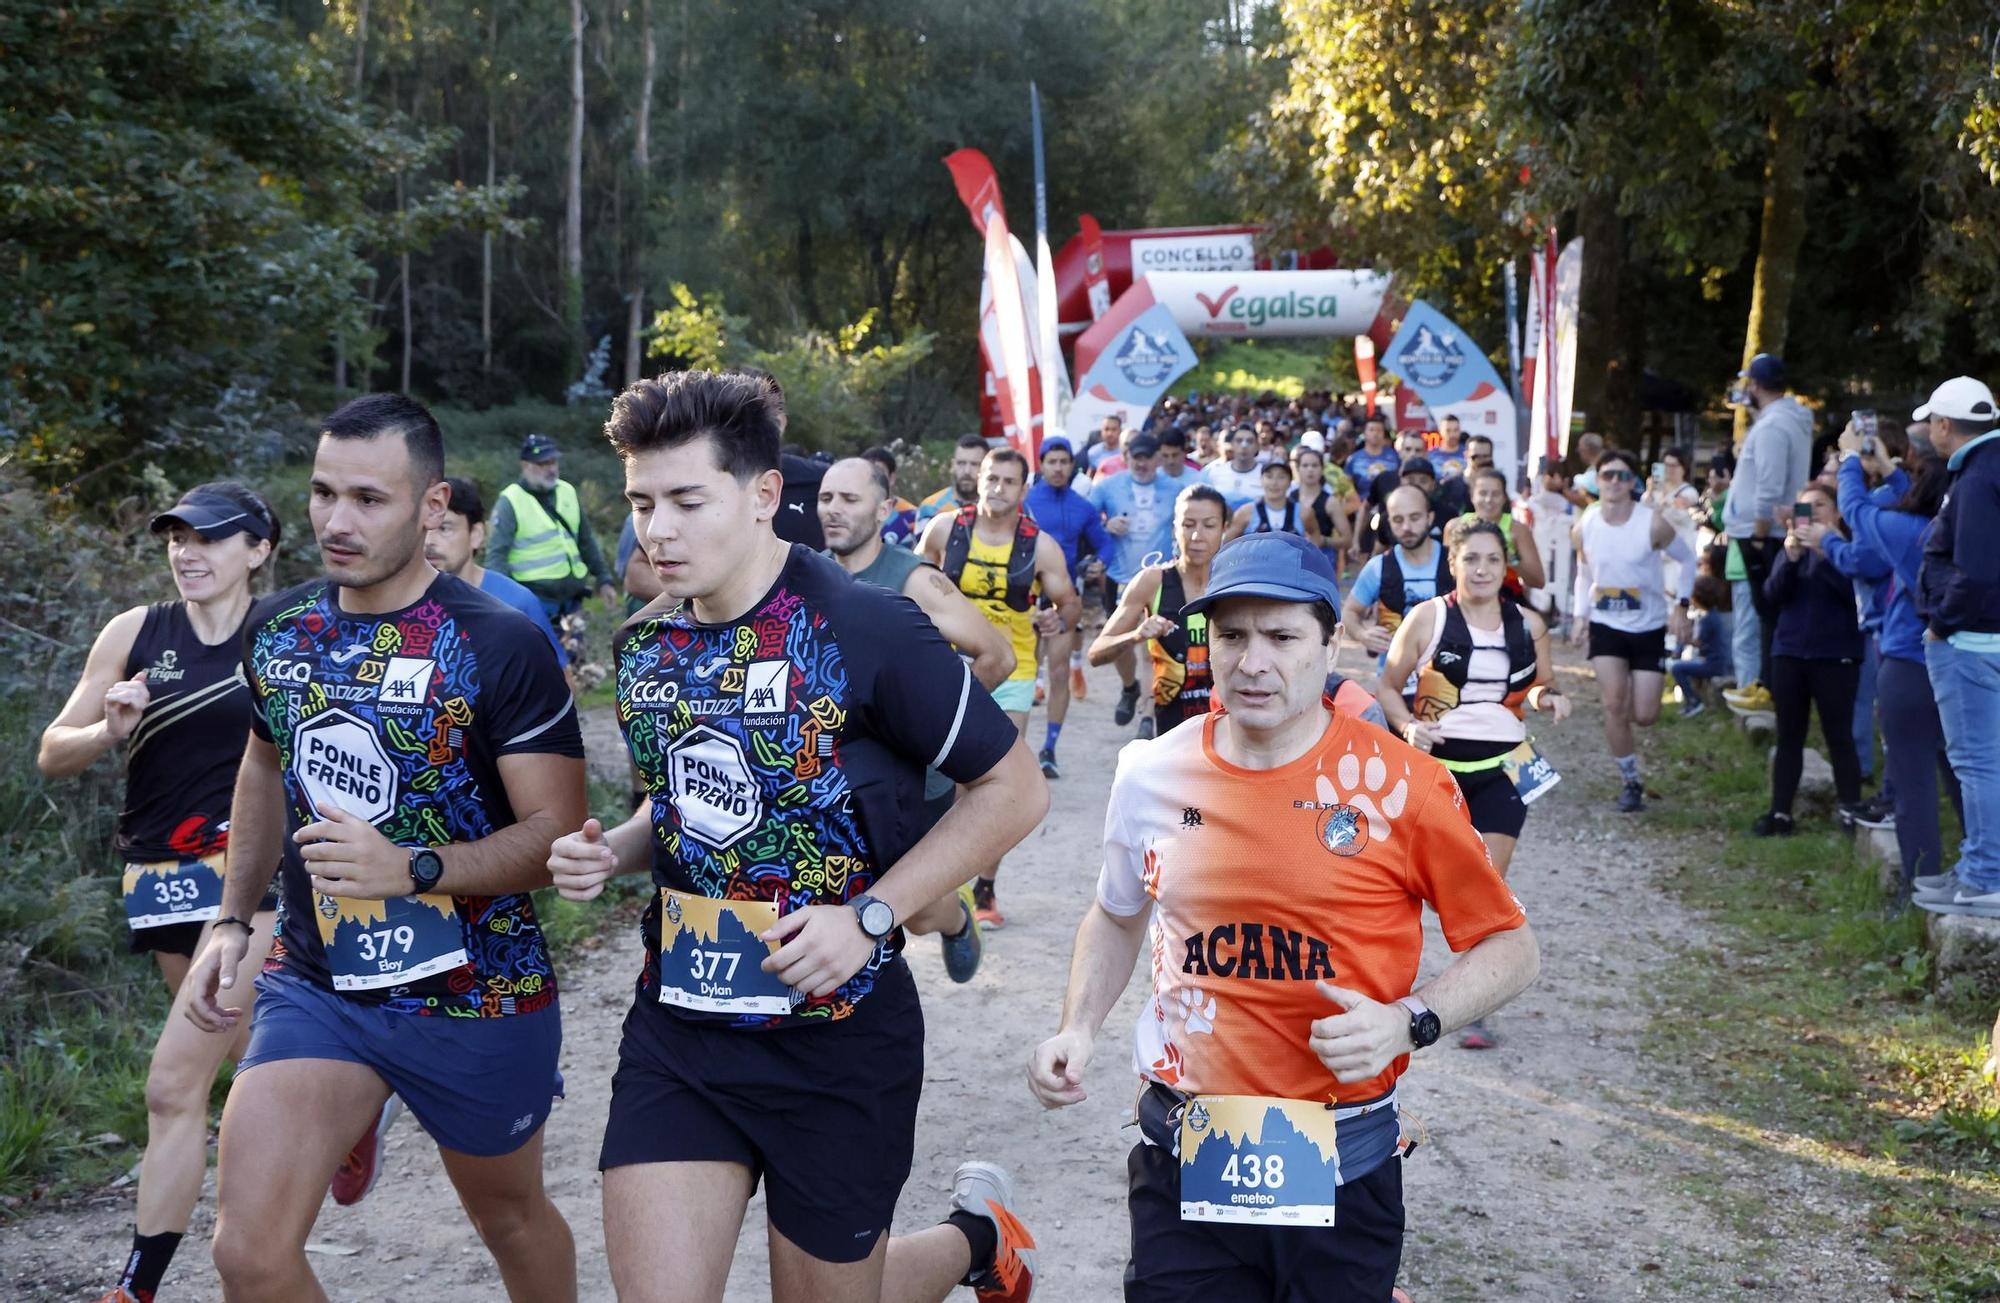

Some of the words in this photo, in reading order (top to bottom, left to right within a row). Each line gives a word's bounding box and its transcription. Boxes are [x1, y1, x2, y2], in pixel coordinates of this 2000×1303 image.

[1141, 246, 1244, 264] CONCELLO
[1195, 285, 1337, 326] Vegalsa
[149, 667, 185, 682] Trigal
[380, 680, 416, 699] AXA
[745, 687, 777, 708] AXA
[376, 703, 423, 716] fundación
[743, 715, 786, 727] fundación
[310, 736, 382, 784] PONLE
[307, 758, 381, 805] FRENO
[682, 755, 747, 794] PONLE
[685, 777, 747, 817] FRENO
[1292, 800, 1341, 812] BALTO
[153, 878, 200, 904] 353
[357, 925, 415, 961] 379
[1182, 923, 1336, 981] ACANA
[378, 959, 403, 972] Eloy
[690, 948, 742, 982] 377
[700, 981, 733, 998] Dylan
[1221, 1153, 1285, 1189] 438
[1231, 1192, 1275, 1205] emeteo
